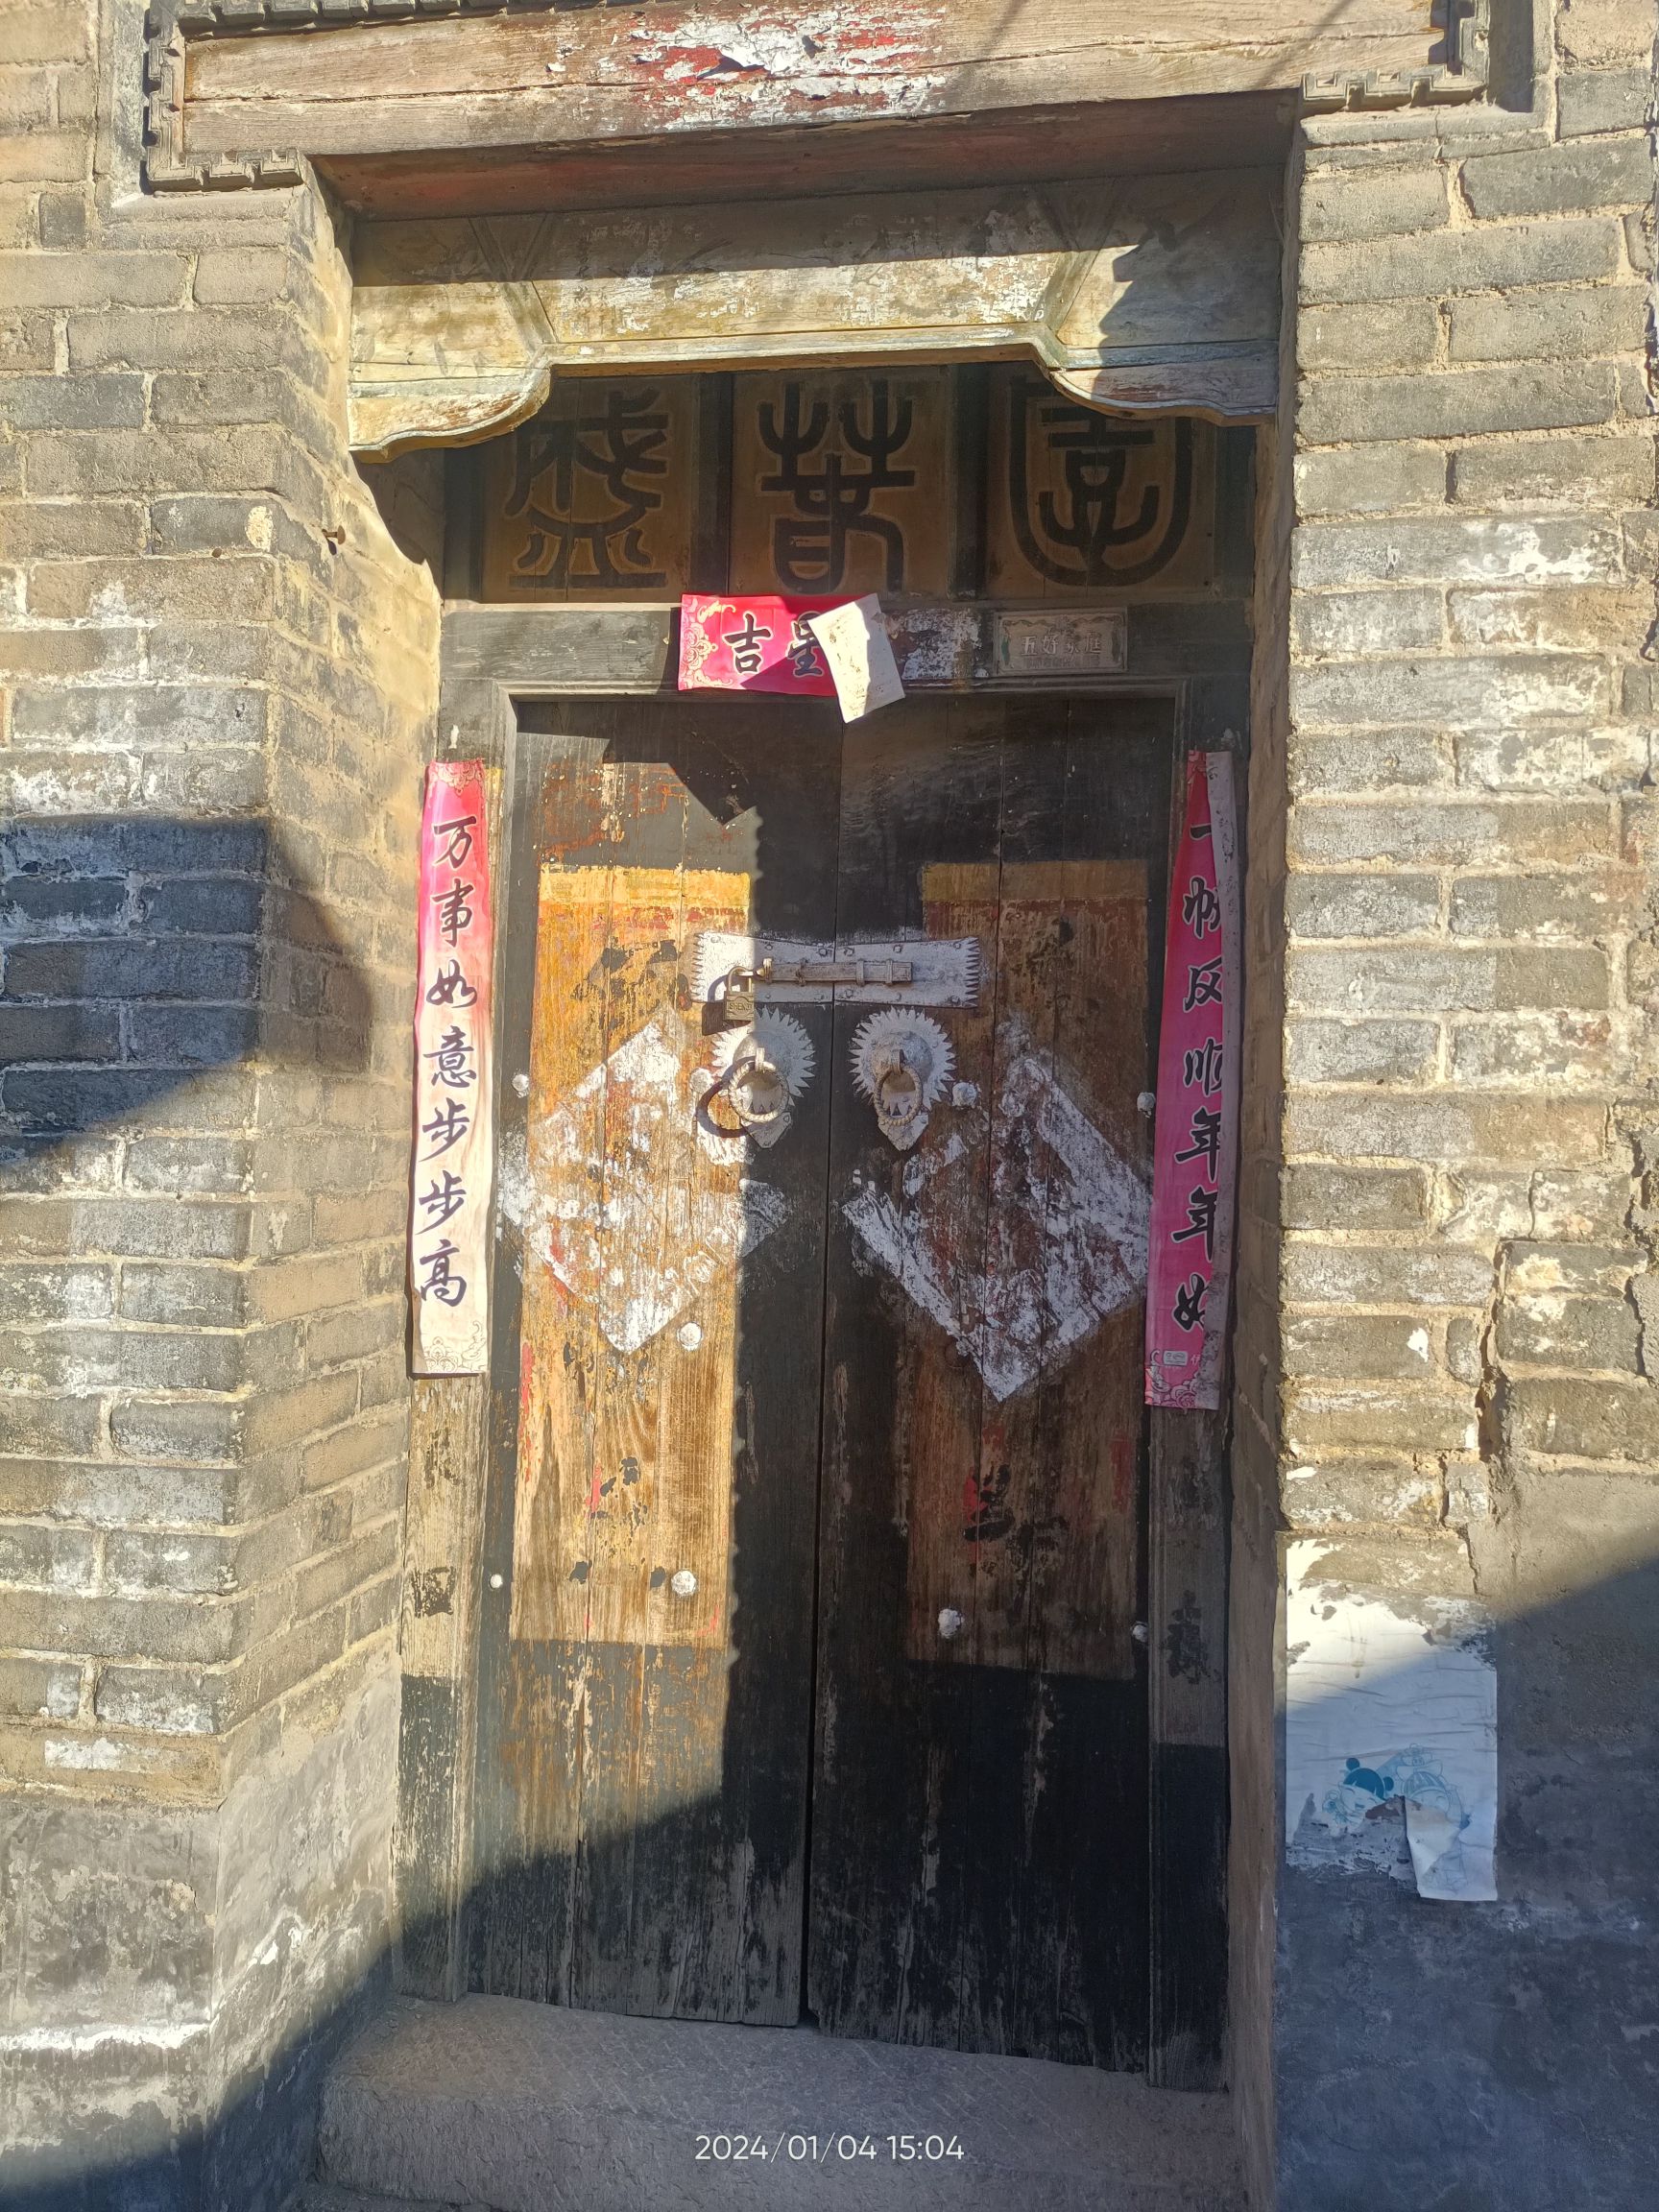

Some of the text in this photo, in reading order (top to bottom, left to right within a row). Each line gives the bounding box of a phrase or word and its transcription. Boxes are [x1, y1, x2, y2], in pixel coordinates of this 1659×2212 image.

[1021, 628, 1102, 657] 五好家庭
[415, 815, 479, 1310] 万事如意步步高
